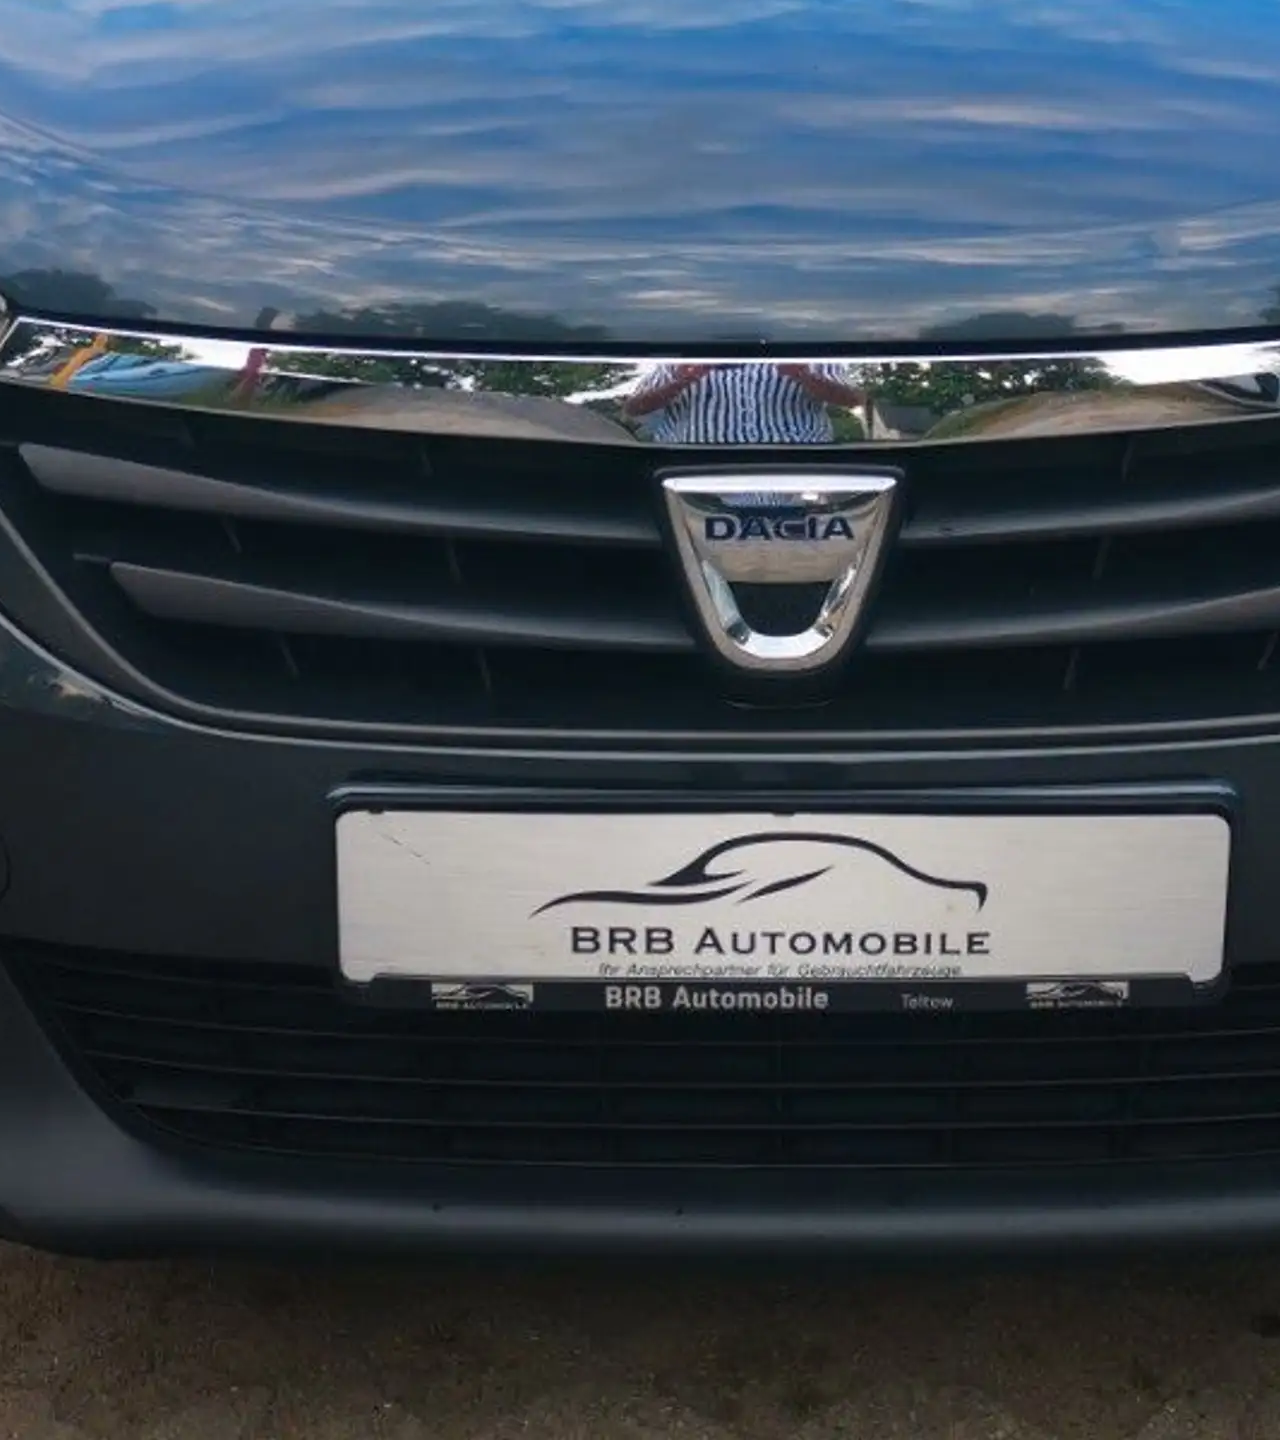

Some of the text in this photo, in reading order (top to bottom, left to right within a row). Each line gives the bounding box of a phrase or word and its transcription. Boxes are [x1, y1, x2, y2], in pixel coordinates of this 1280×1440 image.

[704, 515, 855, 541] DACIA
[572, 926, 675, 955] BRB
[604, 984, 830, 1010] BRB Automobile
